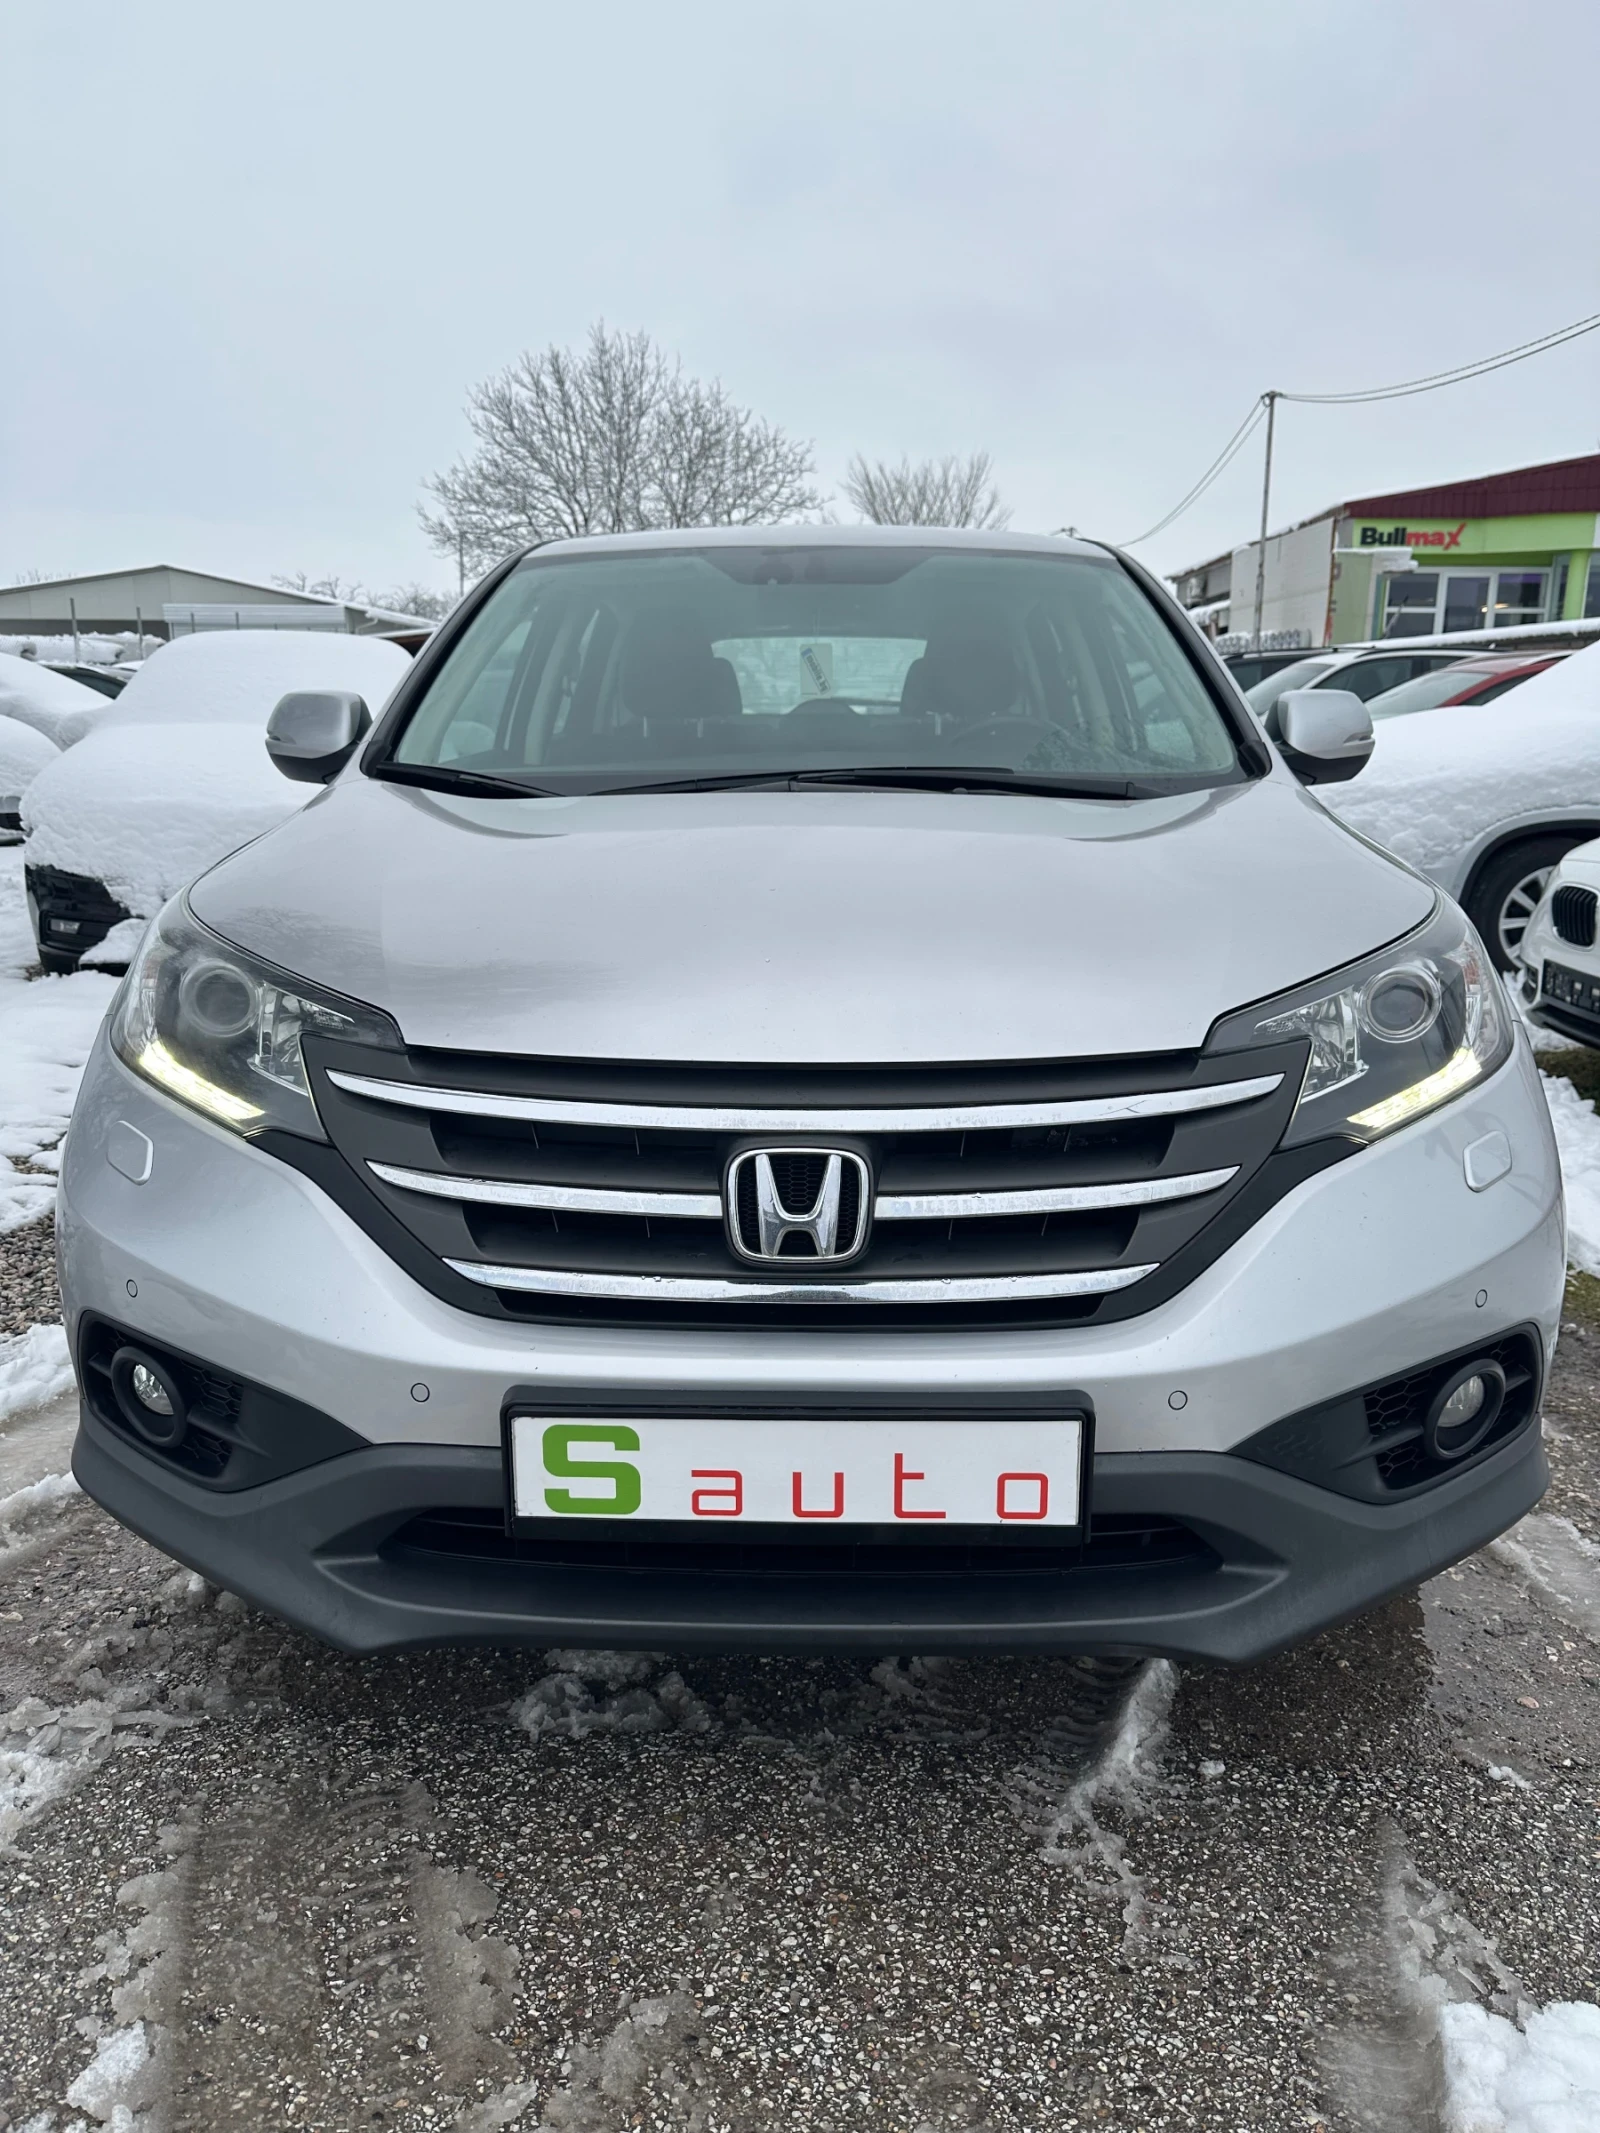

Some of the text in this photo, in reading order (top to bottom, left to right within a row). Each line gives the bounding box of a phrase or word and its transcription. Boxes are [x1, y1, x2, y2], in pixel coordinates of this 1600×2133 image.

[1360, 522, 1467, 551] Bullmax
[542, 1424, 1049, 1520] S auto
